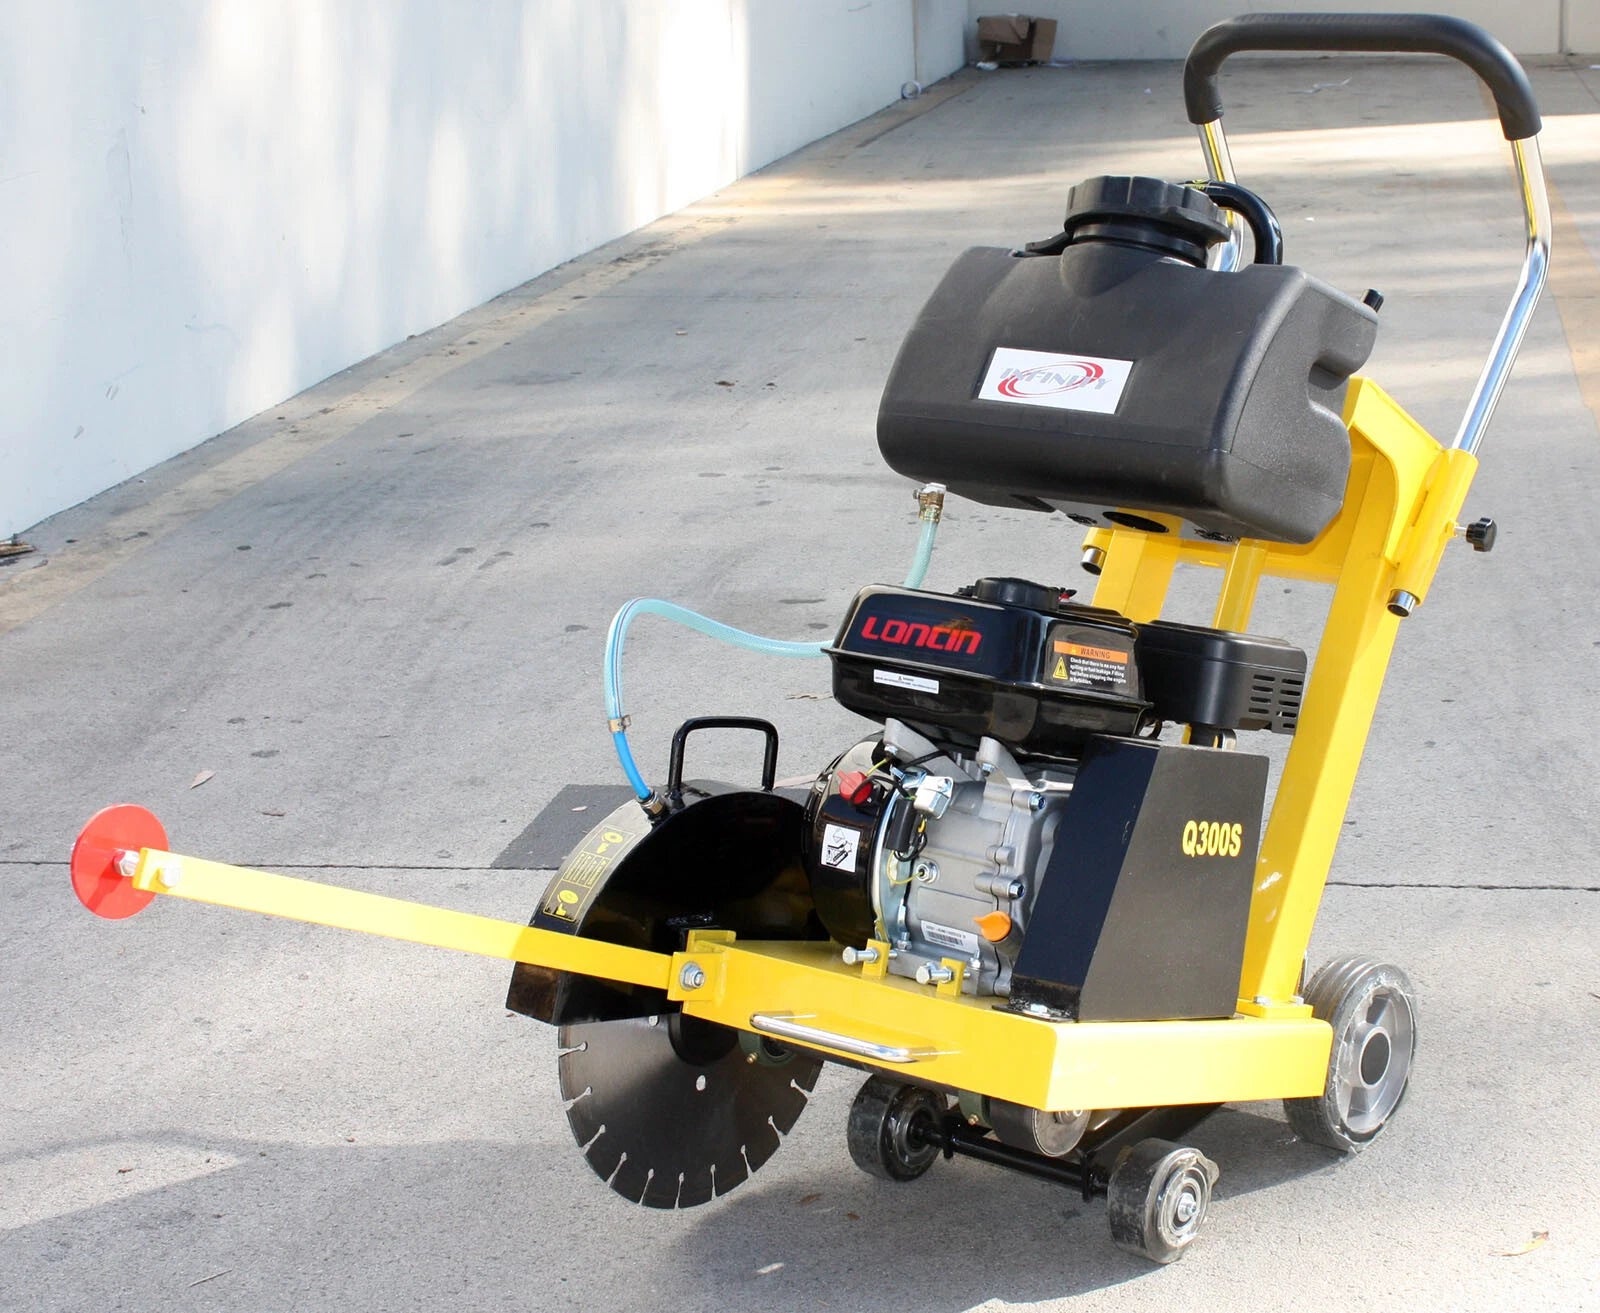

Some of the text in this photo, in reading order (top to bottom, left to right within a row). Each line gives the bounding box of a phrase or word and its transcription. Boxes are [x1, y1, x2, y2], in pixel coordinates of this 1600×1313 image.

[861, 616, 982, 655] LONCIN
[1070, 656, 1082, 664] Check
[1080, 647, 1111, 659] WARNING
[1182, 820, 1242, 858] Q300S
